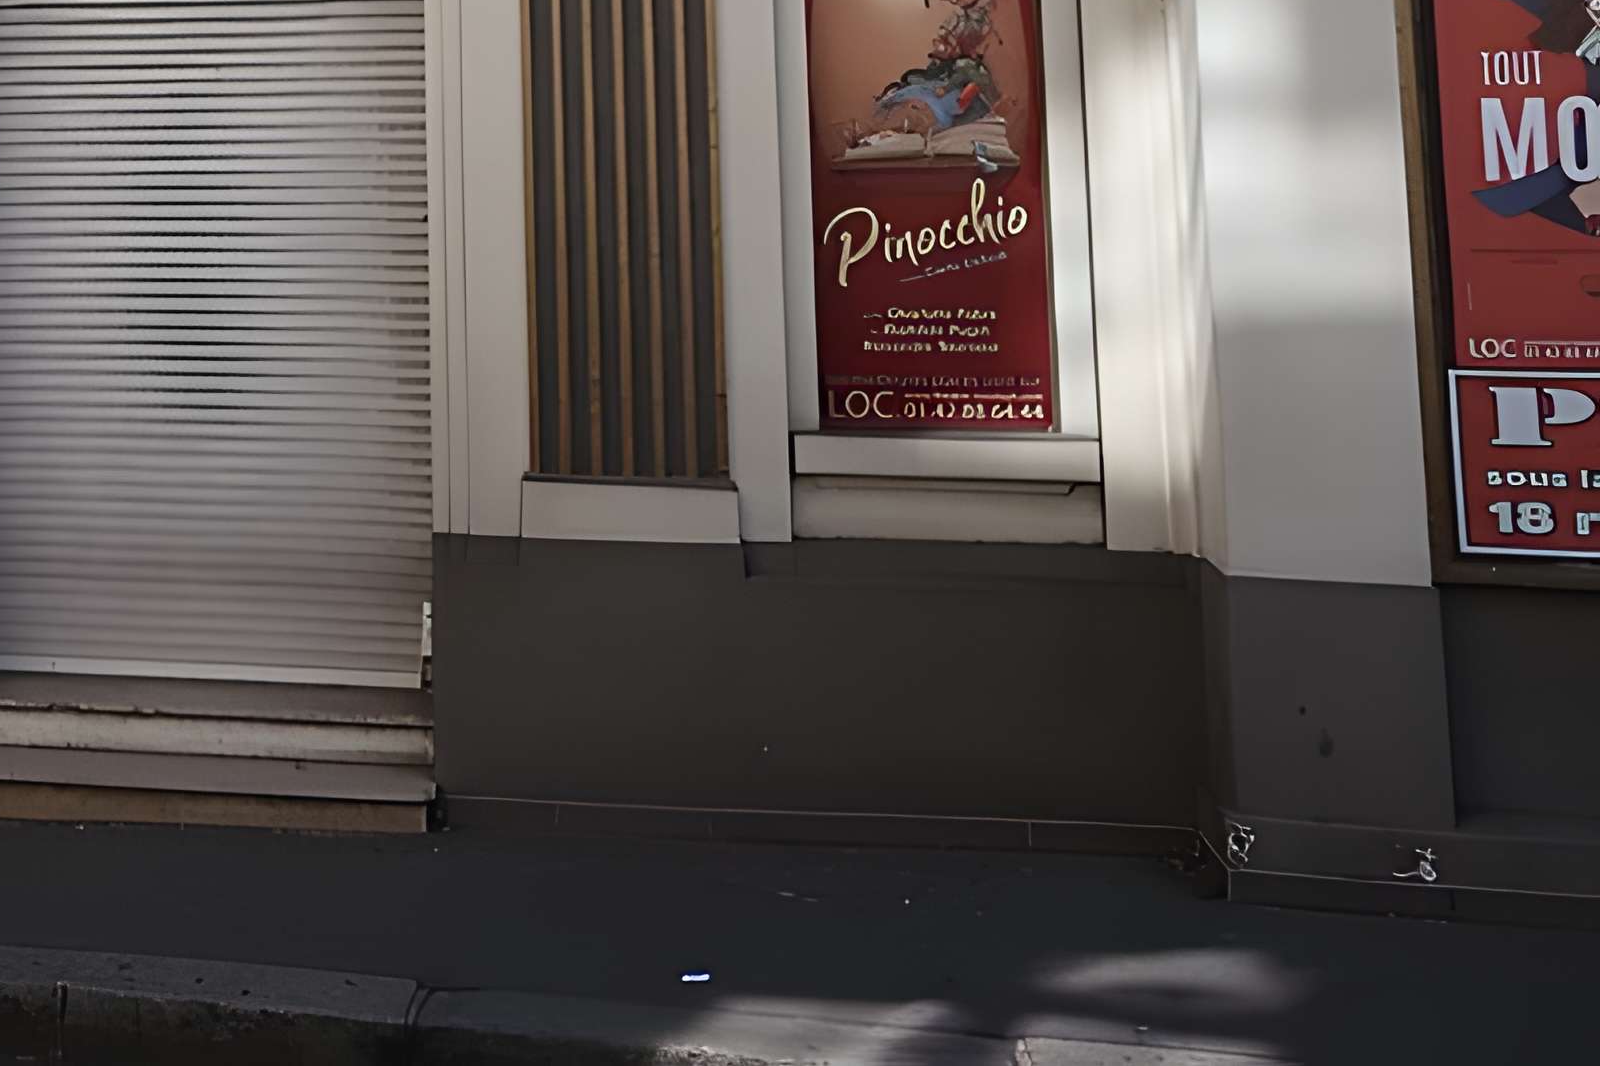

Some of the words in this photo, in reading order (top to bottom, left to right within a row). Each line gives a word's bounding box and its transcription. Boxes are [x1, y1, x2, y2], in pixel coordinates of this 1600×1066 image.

[1480, 50, 1543, 85] TOUT
[1480, 95, 1600, 182] MO
[823, 177, 1028, 287] Pinocchio
[1468, 338, 1517, 359] LOC
[1488, 501, 1555, 534] 18
